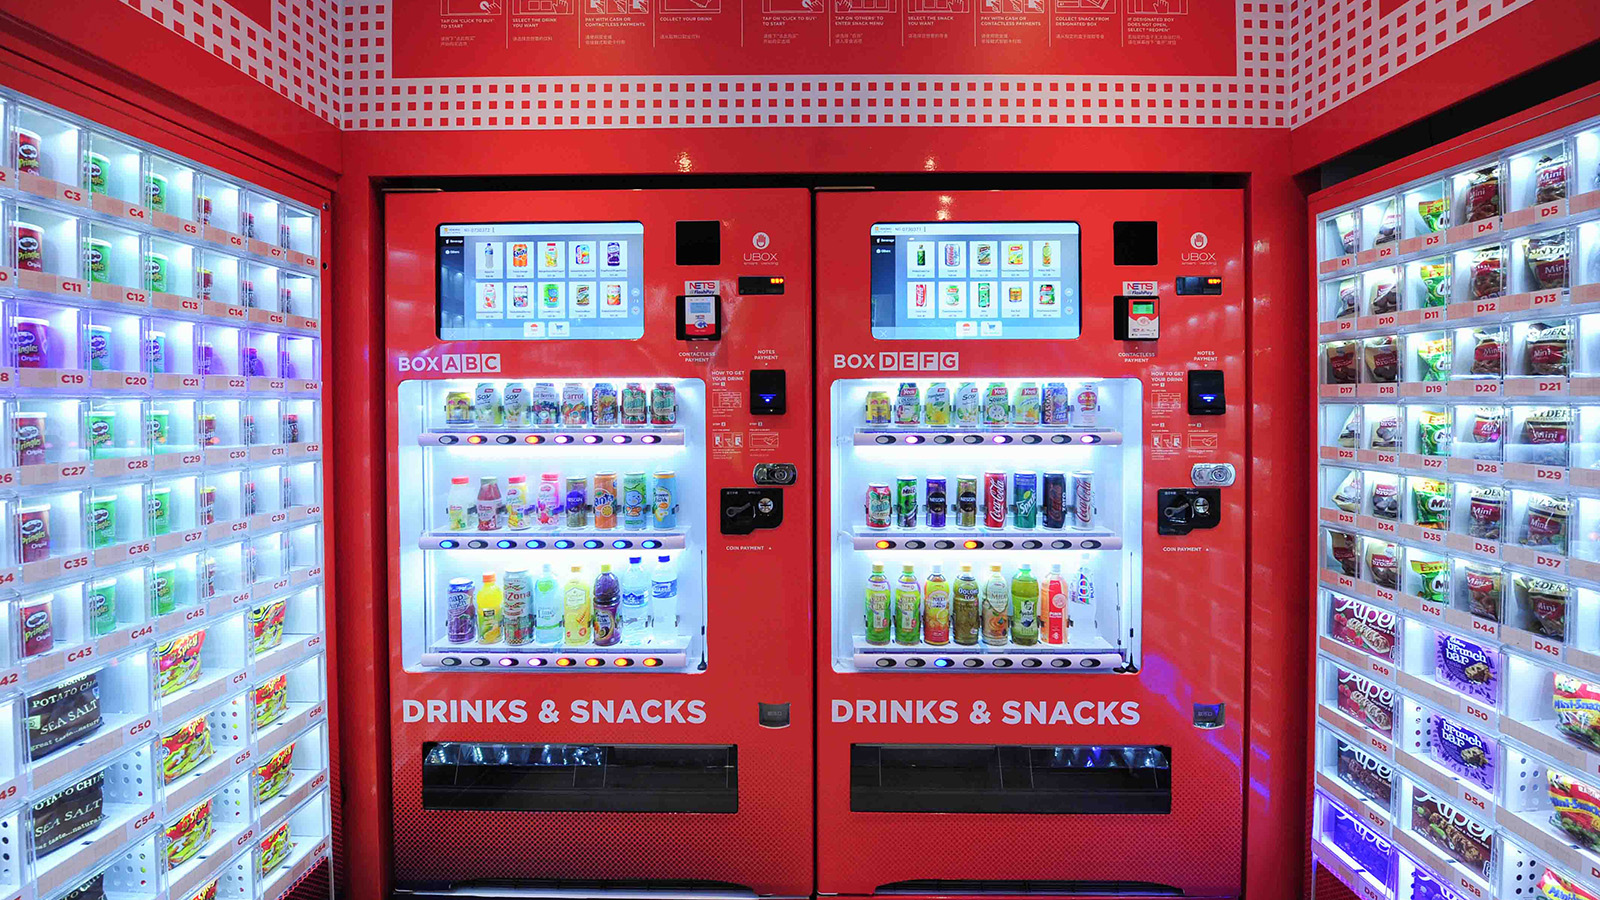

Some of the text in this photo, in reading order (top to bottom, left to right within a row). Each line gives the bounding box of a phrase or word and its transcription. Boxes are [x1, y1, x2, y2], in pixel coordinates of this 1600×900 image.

[1539, 167, 1564, 181] Mini
[64, 190, 81, 202] C3
[129, 208, 144, 219] C4
[1541, 206, 1558, 217] D5
[184, 224, 197, 234] C5
[1478, 222, 1493, 233] D4
[230, 236, 242, 246] C6
[1427, 236, 1439, 246] D3
[271, 248, 281, 257] C7
[743, 252, 778, 261] UBOX
[1181, 252, 1216, 261] UBOX
[1380, 248, 1391, 257] D2
[1341, 258, 1350, 267] D1
[62, 282, 82, 293] C11
[126, 292, 145, 303] C12
[1535, 293, 1556, 304] D13
[181, 300, 199, 311] C13
[1477, 303, 1496, 314] D12
[228, 308, 243, 316] C14
[1424, 311, 1439, 319] D11
[270, 314, 283, 323] C15
[1379, 316, 1394, 325] D10
[1341, 321, 1350, 329] D9
[398, 356, 440, 372] BOX
[833, 354, 876, 369] BOX
[61, 374, 83, 384] C19
[125, 376, 147, 386] C20
[183, 379, 199, 387] C21
[229, 379, 245, 387] C22
[305, 382, 318, 390] C24
[1340, 386, 1352, 394] D17
[1380, 386, 1394, 394] D18
[1426, 385, 1442, 393] D19
[1475, 383, 1497, 393] D20
[1539, 382, 1561, 391] D21
[183, 454, 201, 464] C29
[230, 451, 246, 459] C30
[1339, 450, 1353, 459] D25
[1378, 454, 1394, 463] D26
[127, 460, 149, 470] C28
[1424, 459, 1442, 468] D27
[1476, 463, 1497, 473] D28
[62, 466, 86, 477] C27
[1537, 470, 1562, 480] D29
[307, 506, 321, 514] C40
[271, 513, 286, 522] C39
[232, 522, 248, 531] C38
[1378, 522, 1394, 531] D34
[184, 532, 202, 543] C37
[1423, 531, 1441, 542] D35
[129, 543, 150, 555] C36
[1475, 542, 1496, 554] D36
[64, 557, 88, 570] C35
[1537, 556, 1561, 568] D37
[273, 580, 288, 590] C47
[1339, 577, 1352, 587] D41
[233, 592, 249, 604] C46
[1377, 590, 1393, 601] D42
[186, 609, 205, 621] C45
[1422, 604, 1440, 616] D43
[131, 626, 153, 640] C44
[1473, 621, 1495, 634] D44
[308, 637, 321, 647] C52
[1446, 640, 1487, 663] brunch
[1535, 641, 1559, 656] D45
[68, 647, 92, 663] C43
[1445, 648, 1469, 665] bar
[1373, 663, 1389, 676] D49
[233, 672, 248, 684] C51
[32, 687, 77, 708] POTATO
[309, 705, 322, 718] C56
[402, 699, 707, 724] DRINKS & SNACKS
[831, 699, 1141, 725] DRINKS & SNACKS
[1467, 705, 1488, 721] D50
[40, 700, 98, 735] SEA SALT
[130, 719, 152, 736] C50
[1441, 730, 1465, 748] bar
[1442, 720, 1482, 747] brunch
[1371, 737, 1387, 752] D53
[235, 750, 252, 765] C55
[1465, 792, 1485, 810] D54
[35, 799, 102, 837] SEA SALT
[134, 811, 156, 830] C54
[1370, 811, 1384, 826] D57
[238, 829, 254, 846] C59
